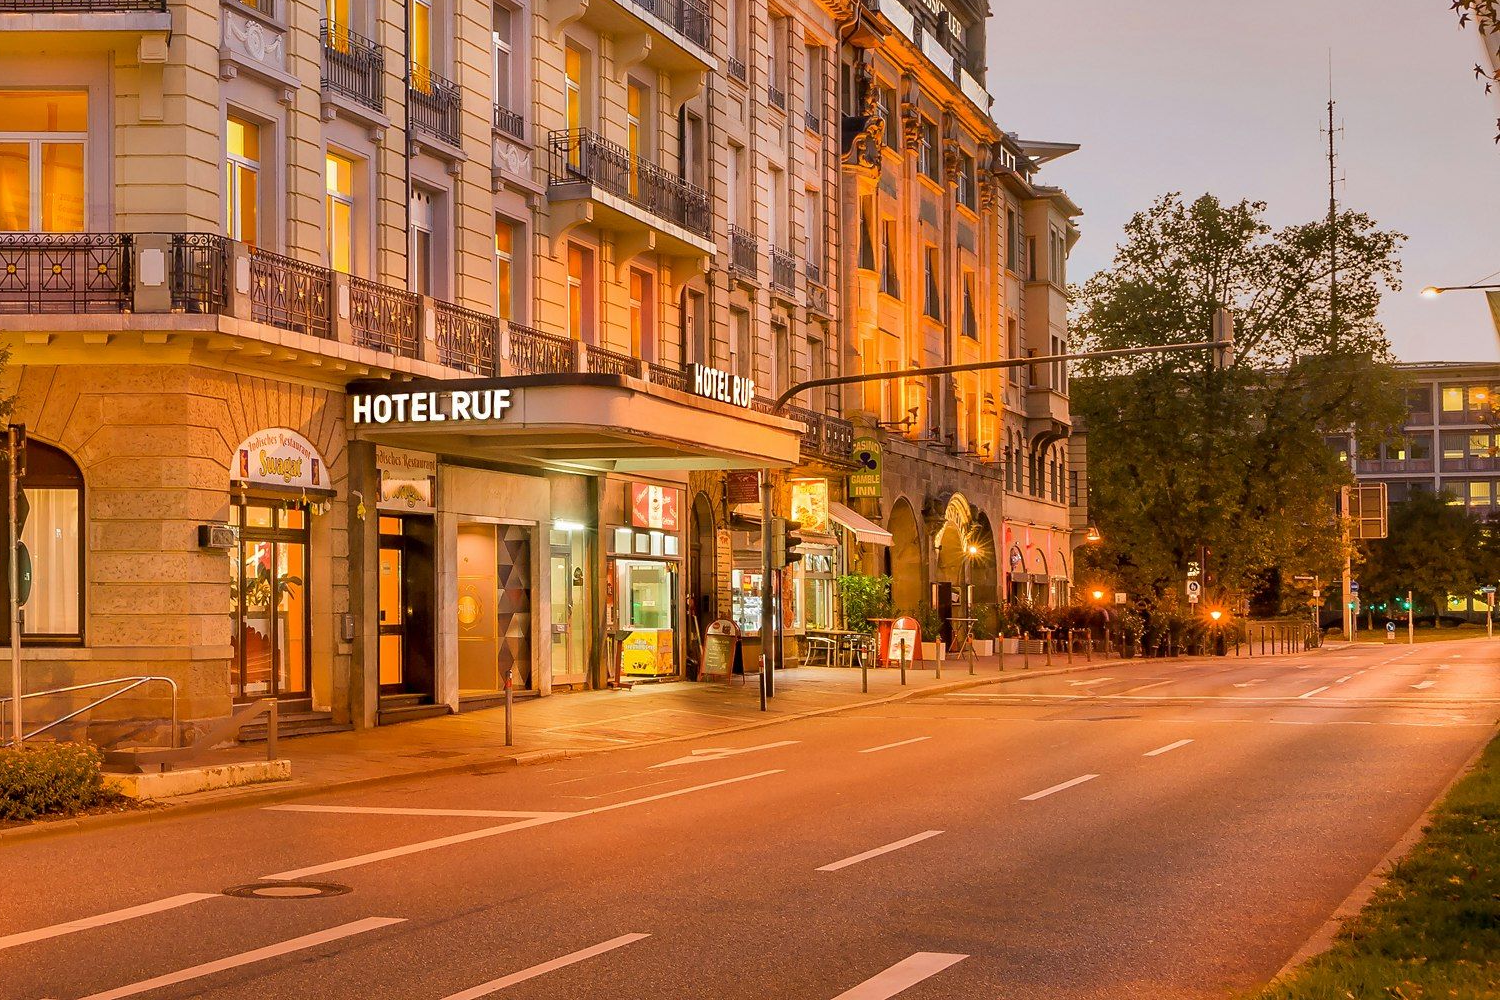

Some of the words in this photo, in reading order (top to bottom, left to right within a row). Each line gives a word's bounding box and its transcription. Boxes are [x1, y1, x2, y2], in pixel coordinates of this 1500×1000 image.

[695, 362, 731, 403] HOTEL
[733, 374, 755, 409] RUF
[353, 391, 446, 423] HOTEL
[451, 389, 510, 420] RUF
[248, 433, 277, 452] Indisches
[279, 433, 311, 460] Restaurant
[259, 449, 302, 483] Swagat
[376, 450, 401, 466] ndisches
[402, 453, 435, 471] Restaurant
[851, 474, 880, 484] GAMBLE
[855, 486, 876, 496] INN
